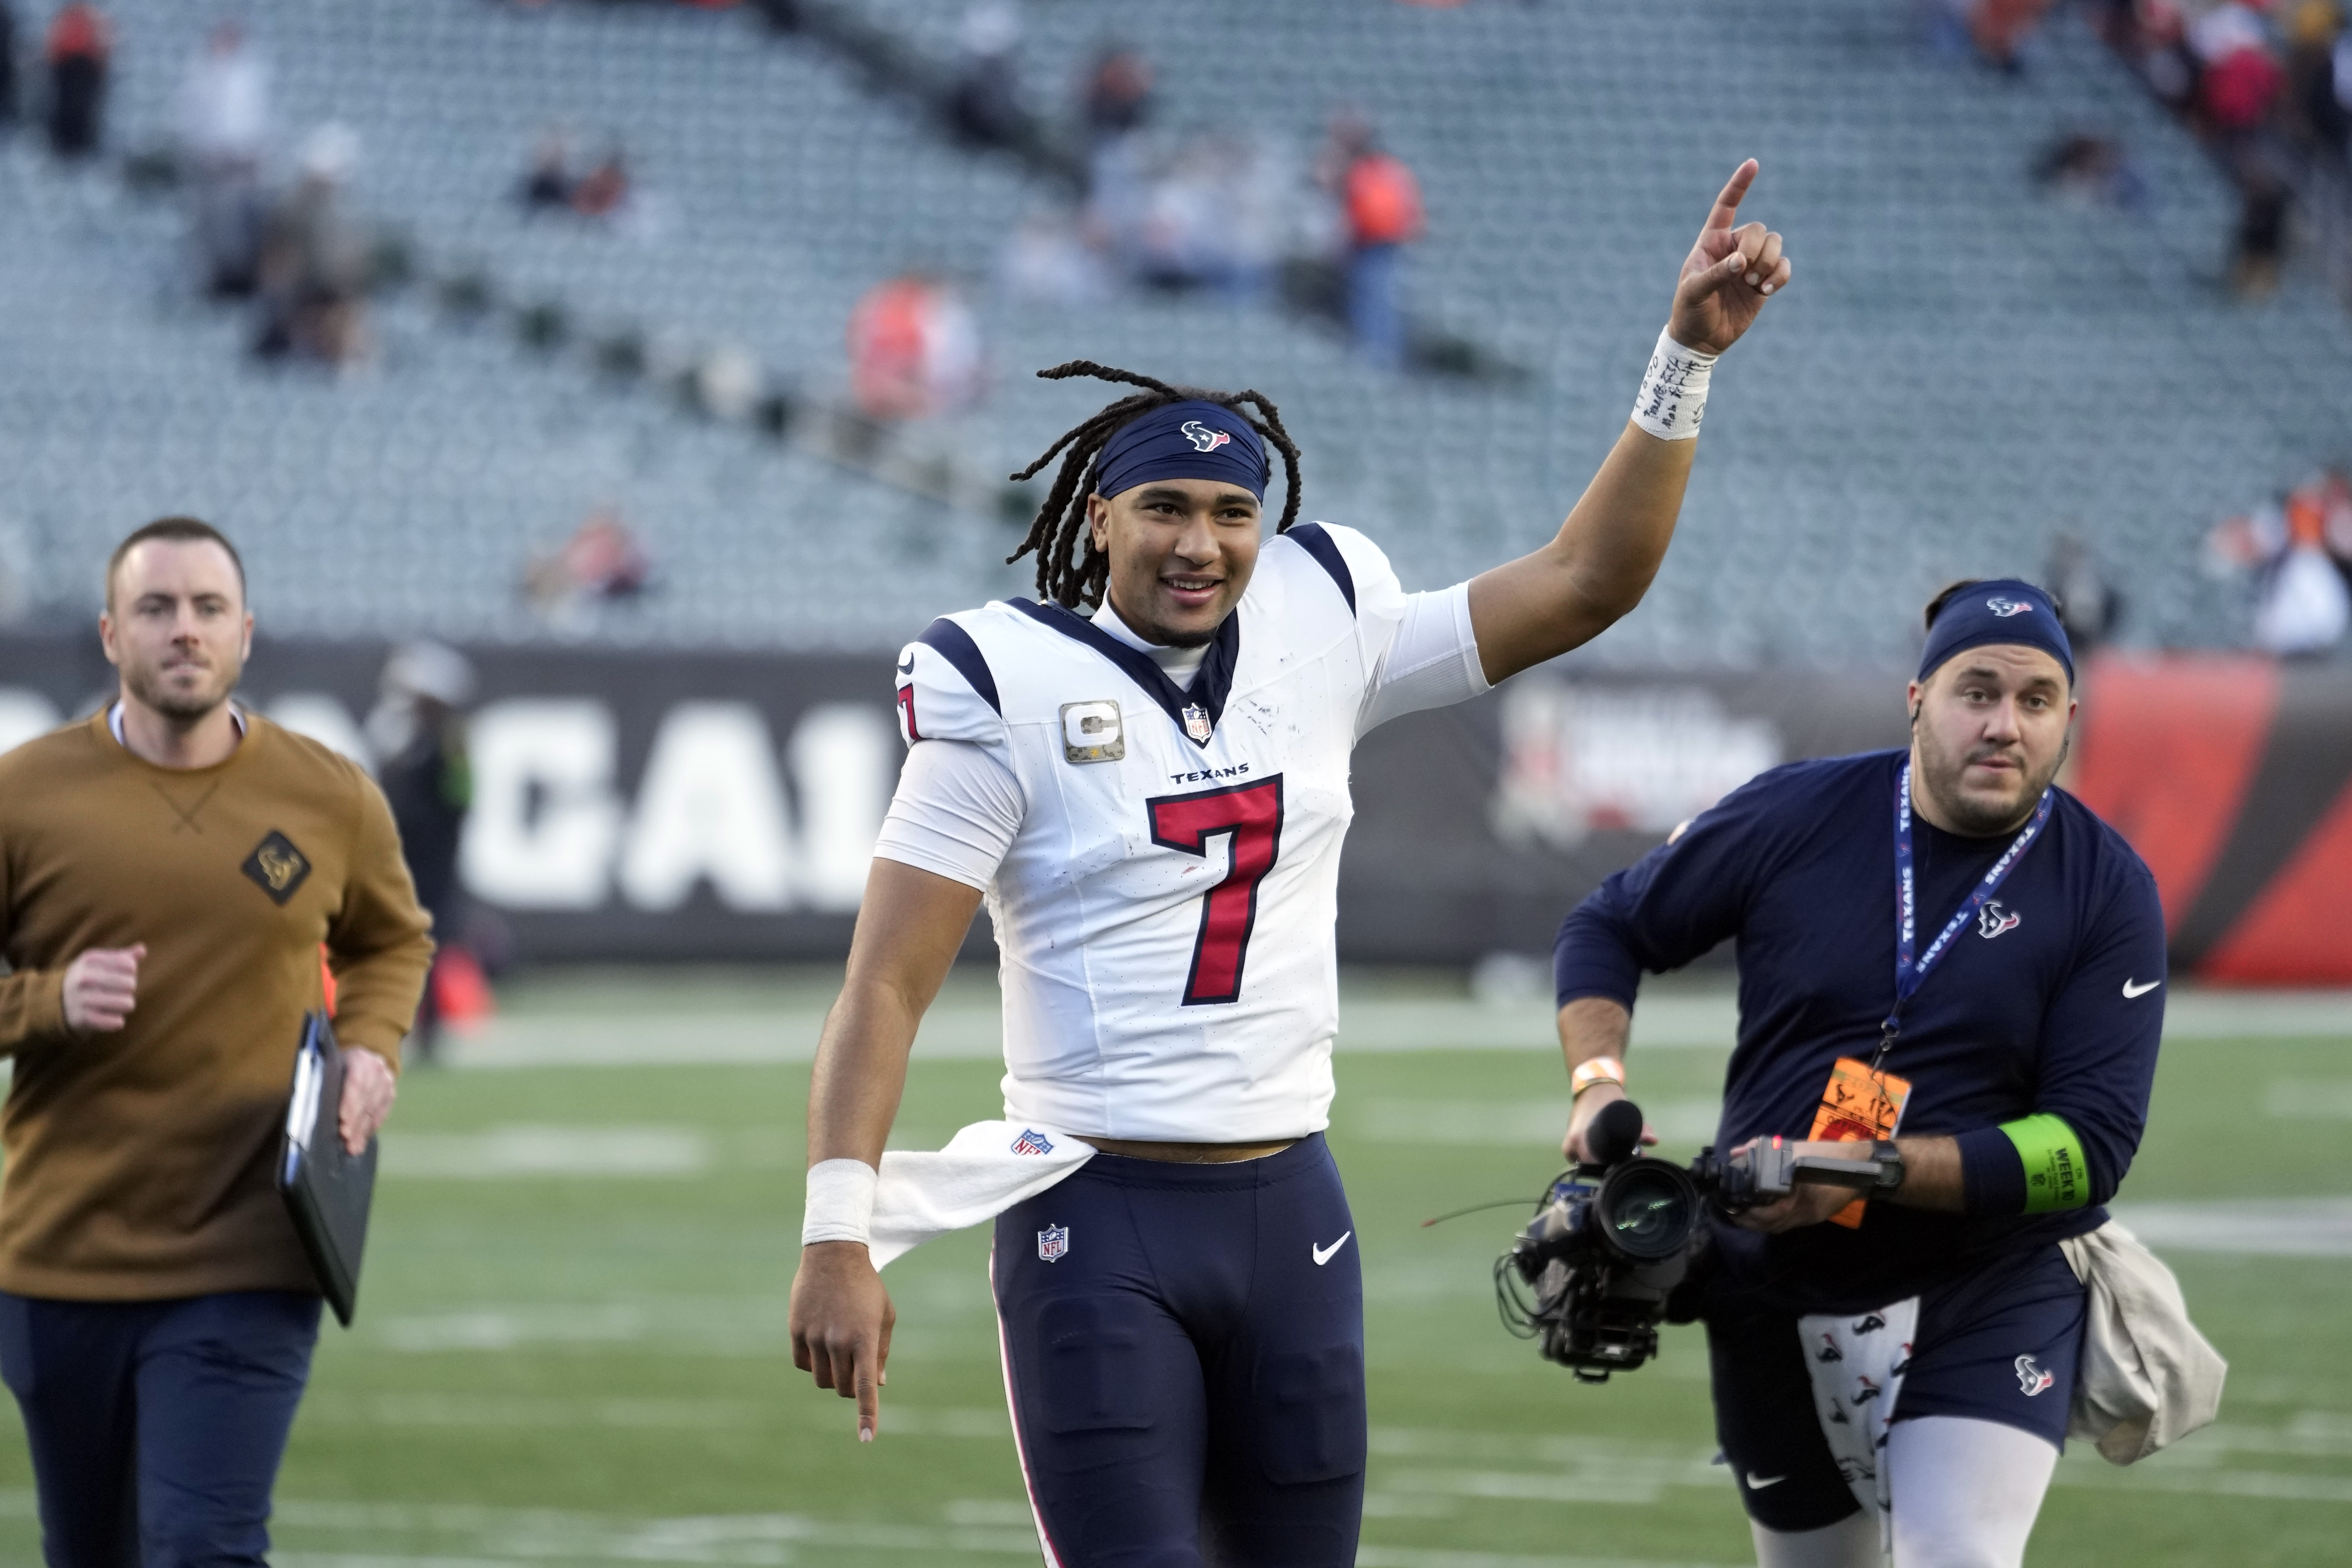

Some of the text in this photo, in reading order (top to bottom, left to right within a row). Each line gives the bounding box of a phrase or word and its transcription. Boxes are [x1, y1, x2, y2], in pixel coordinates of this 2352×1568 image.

[898, 682, 922, 740] 7
[1065, 704, 1118, 748] C
[1192, 721, 1208, 734] NFL
[1170, 763, 1249, 784] TEXANS
[1900, 765, 1911, 833] TEXANS
[1985, 827, 2036, 885] TEXANS
[1146, 773, 1284, 1006] 7
[1902, 867, 1913, 943] TEXANS
[1916, 912, 1969, 973] TEXANS
[2055, 1148, 2074, 1188] WEEK
[2062, 1190, 2075, 1201] 10
[1043, 1241, 1061, 1256] NFL
